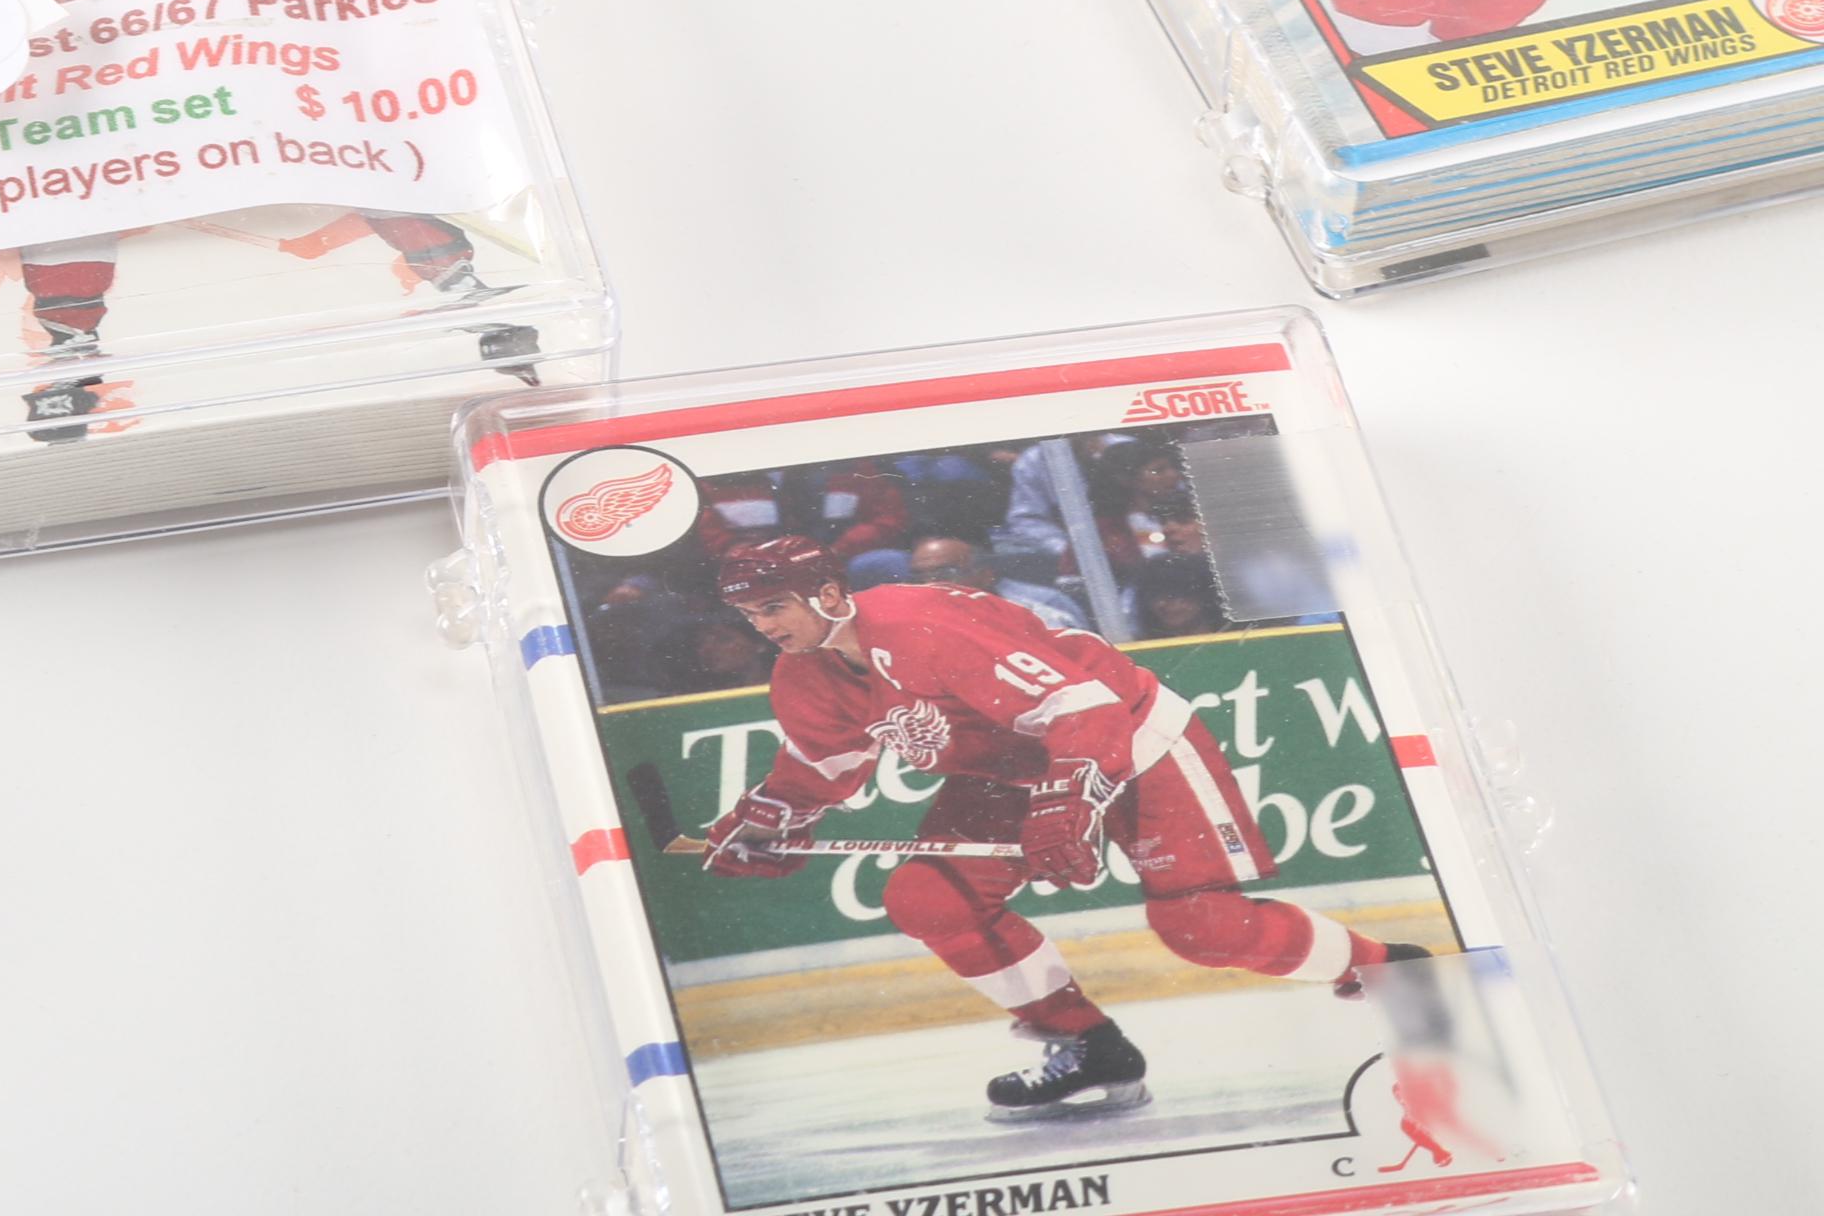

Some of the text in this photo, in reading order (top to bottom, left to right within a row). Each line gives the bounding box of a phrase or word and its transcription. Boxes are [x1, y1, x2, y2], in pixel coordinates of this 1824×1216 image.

[55, 47, 160, 96] Red
[177, 34, 341, 76] Wings
[1426, 6, 1747, 93] STEVE YZERMAN
[1482, 32, 1758, 105] DETROIT RED WINGS
[152, 85, 238, 126] set
[294, 83, 327, 121] $
[341, 68, 479, 124] 10.00
[197, 138, 261, 171] on
[274, 132, 395, 174] back
[1126, 380, 1253, 425] SCORE
[994, 650, 1066, 697] 19
[828, 840, 958, 855] LOUISVILLE
[1331, 1156, 1356, 1178] C
